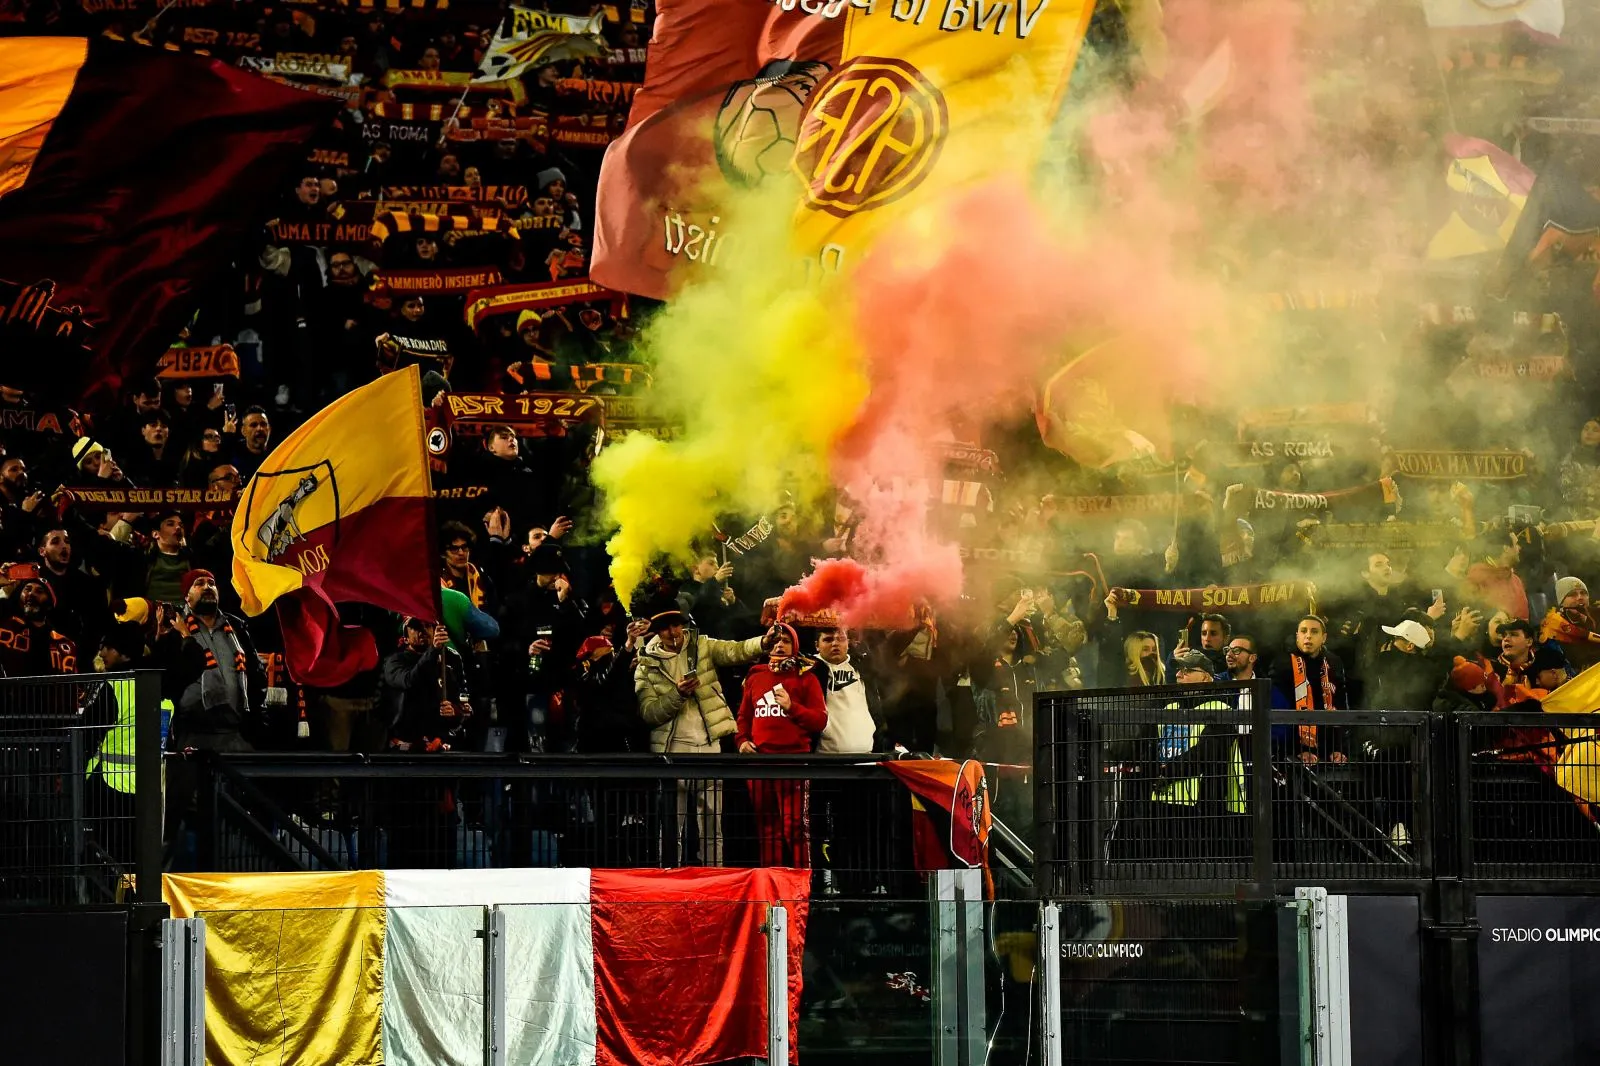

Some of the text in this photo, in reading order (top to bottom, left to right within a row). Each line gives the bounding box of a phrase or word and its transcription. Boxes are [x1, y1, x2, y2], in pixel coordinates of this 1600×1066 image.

[361, 124, 381, 138] AS
[389, 124, 429, 142] ROMA
[445, 274, 485, 289] INSIEME
[174, 350, 213, 372] 1927
[448, 395, 594, 416] ASR 1927
[0, 408, 63, 434] MA
[1251, 441, 1334, 457] AS ROMA
[1396, 453, 1525, 474] ROMA HA VINTO
[78, 489, 126, 503] VOGLIO
[130, 489, 163, 503] SOLO
[166, 489, 201, 503] STAR
[1255, 490, 1328, 509] AS ROMA
[1155, 584, 1295, 606] MAI SOLA MAI
[833, 670, 856, 682] NIKE
[1492, 928, 1600, 942] STADIO OLIMPIC
[1061, 943, 1144, 958] STADIO OLIMPICO
